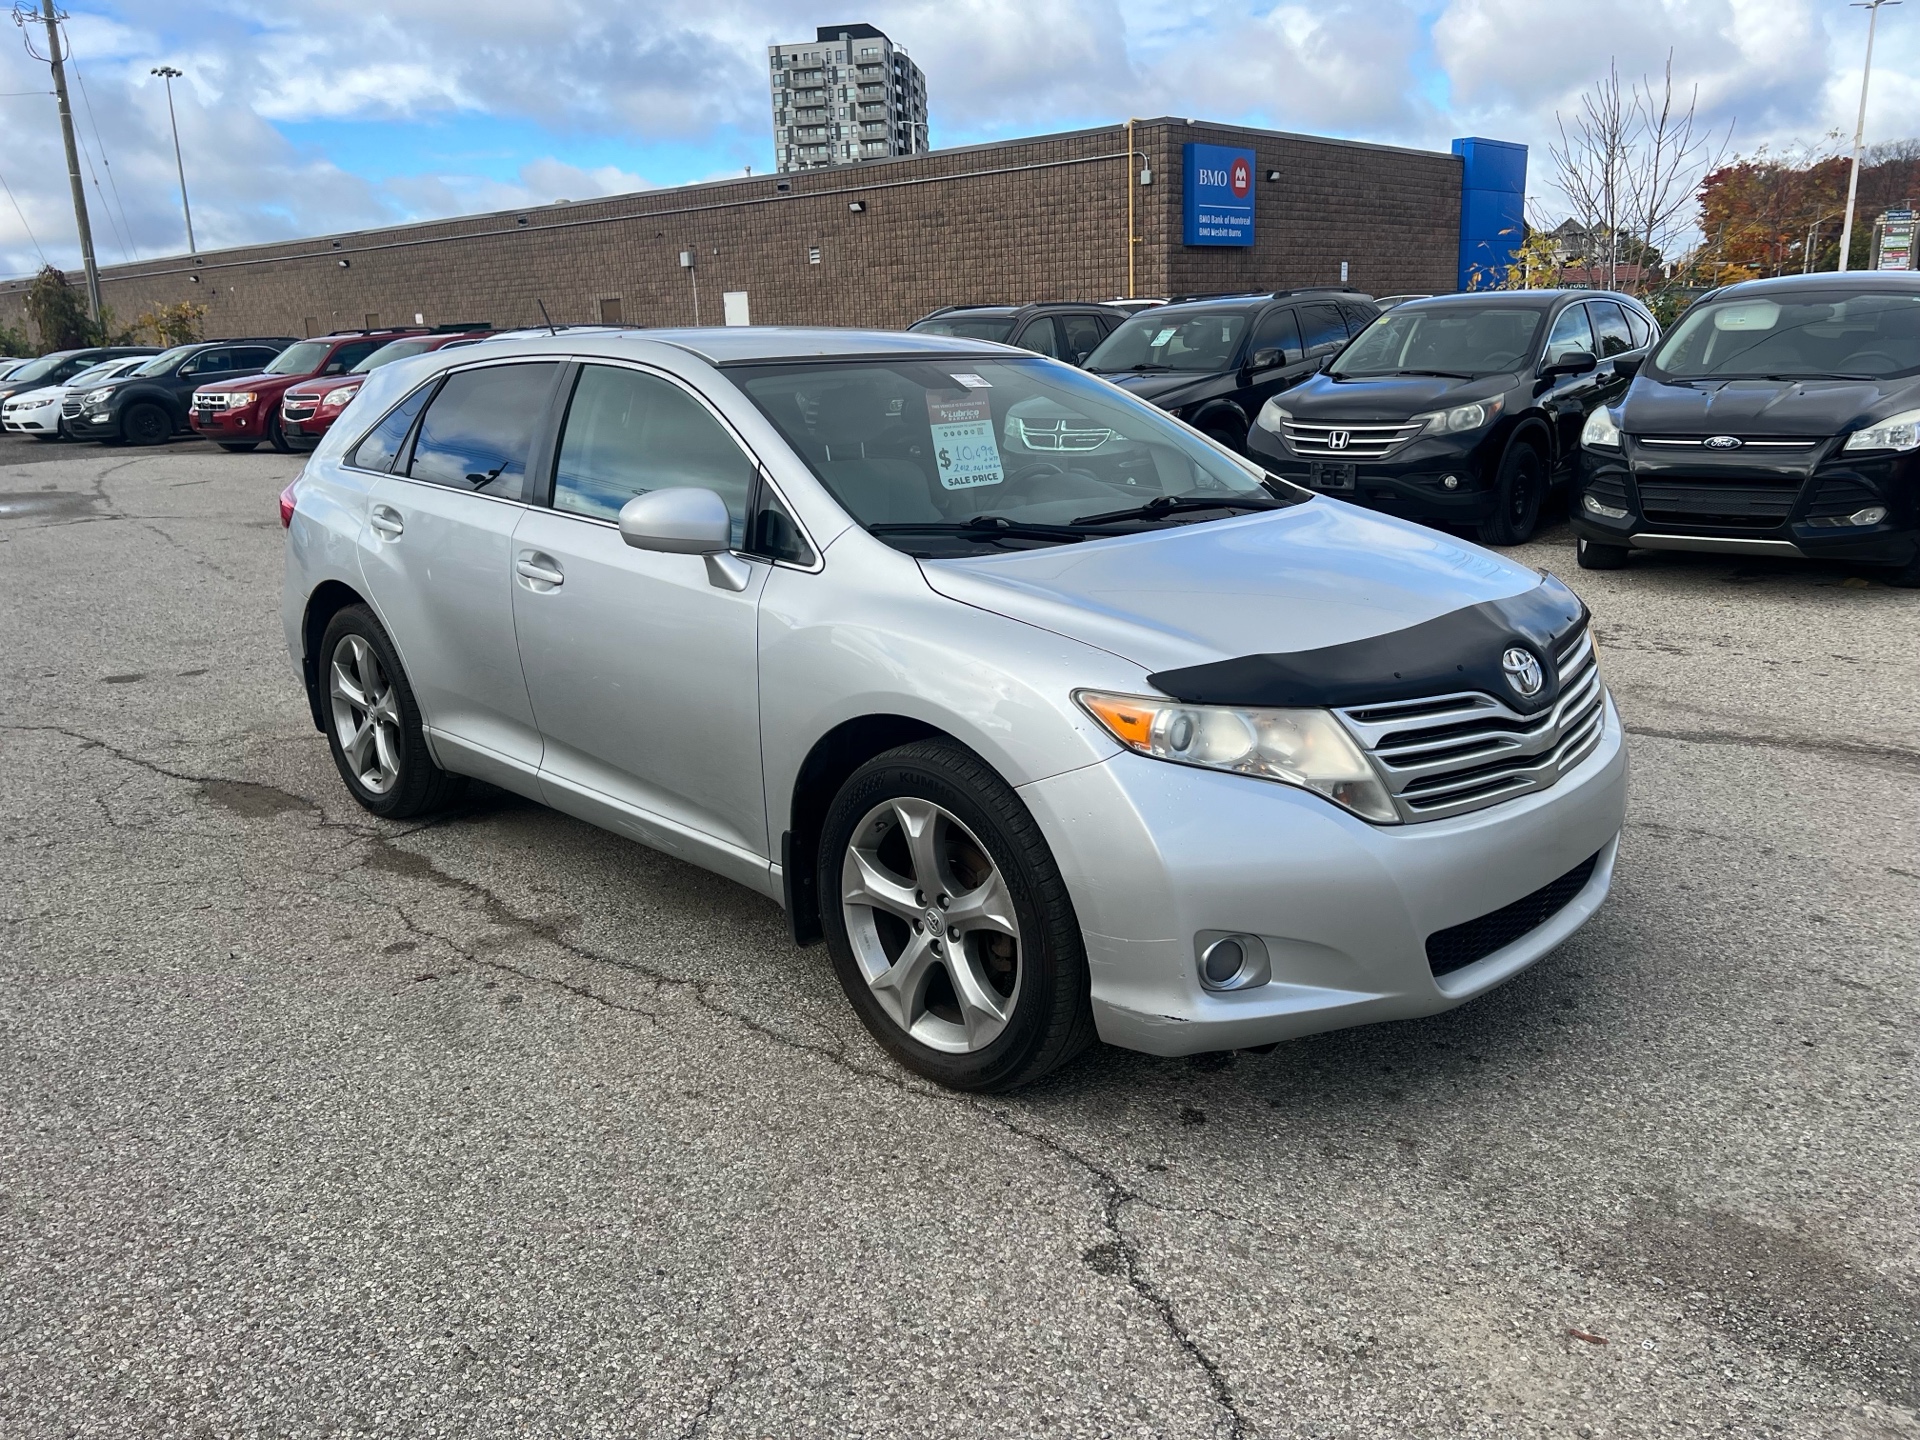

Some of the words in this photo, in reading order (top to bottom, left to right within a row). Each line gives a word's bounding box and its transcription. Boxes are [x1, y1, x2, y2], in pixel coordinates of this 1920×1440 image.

[1199, 169, 1227, 187] BMO
[1198, 214, 1210, 224] BMO
[1211, 215, 1223, 224] Bank
[1224, 215, 1230, 224] of
[1230, 216, 1250, 225] Montreal
[1198, 228, 1210, 236] BMO
[1211, 228, 1228, 236] Nesbitt
[1228, 229, 1242, 237] Burns
[948, 410, 980, 418] Lubrico
[1710, 437, 1733, 447] Ford
[938, 448, 952, 470] $
[948, 476, 970, 486] SALE
[972, 472, 998, 482] PRICE
[900, 772, 956, 802] KUMHO
